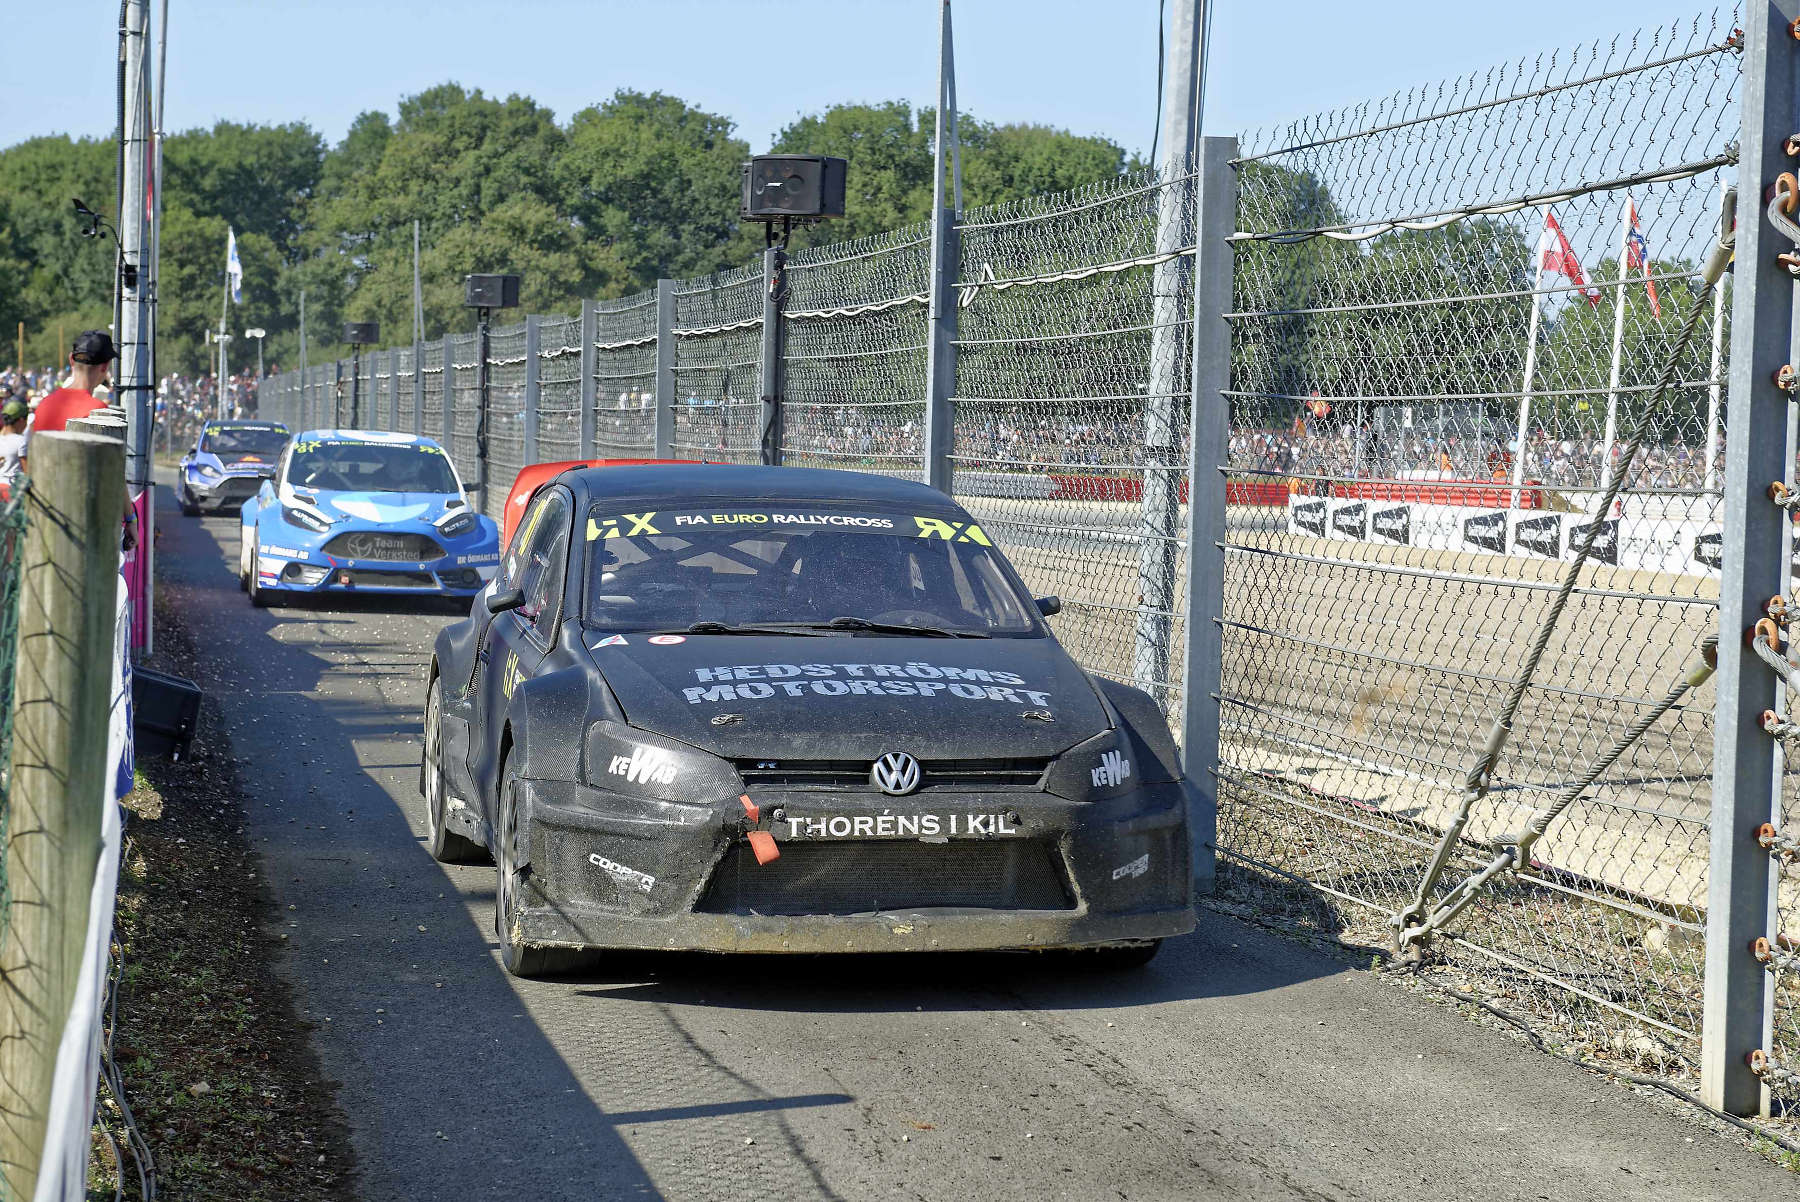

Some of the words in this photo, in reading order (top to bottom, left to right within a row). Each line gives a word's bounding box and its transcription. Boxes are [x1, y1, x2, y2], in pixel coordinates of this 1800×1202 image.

[675, 515, 709, 526] FIA
[711, 514, 769, 524] EURO
[772, 514, 894, 528] RALLYCROSS
[374, 537, 404, 548] Team
[695, 662, 1026, 685] HEDSTRÖMS
[682, 679, 1052, 707] MOTORSPORT
[787, 810, 941, 838] THORÉNS
[950, 814, 958, 835] I
[967, 814, 1017, 835] KIL
